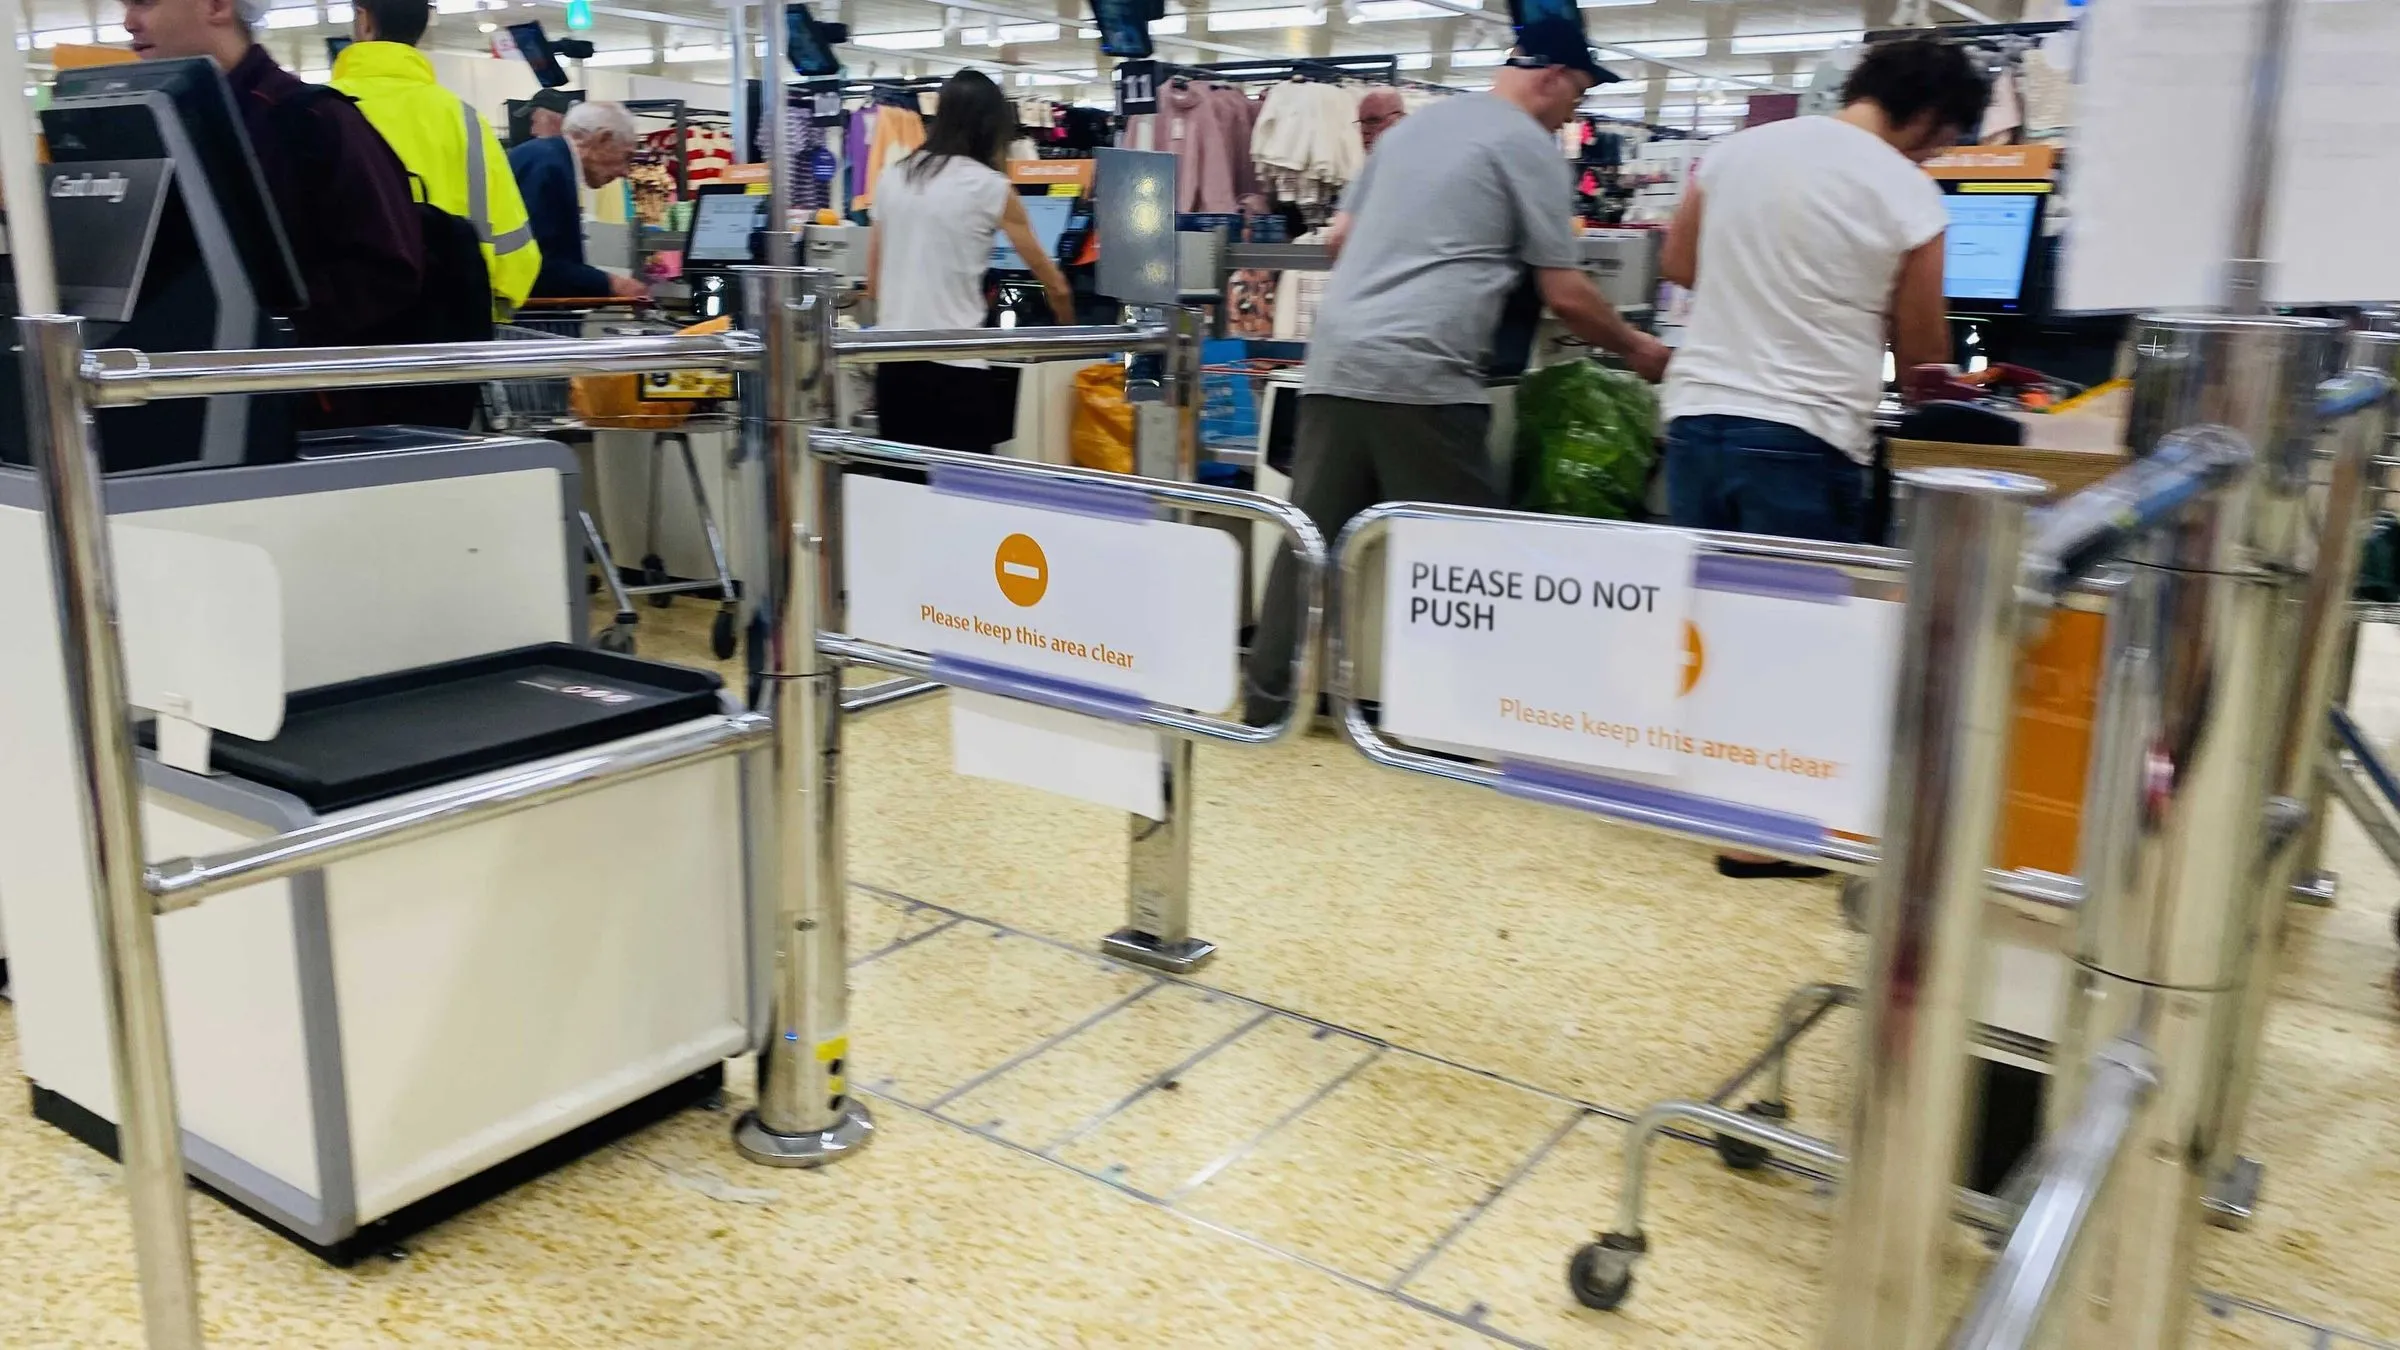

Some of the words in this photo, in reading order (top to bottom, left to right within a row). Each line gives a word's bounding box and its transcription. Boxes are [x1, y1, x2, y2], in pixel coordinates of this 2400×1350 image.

[1410, 597, 1494, 631] PUSH
[1411, 562, 1523, 600] PLEASE
[1534, 574, 1582, 605] DO
[1593, 581, 1660, 613] NOT
[921, 604, 970, 631] Please
[974, 615, 1012, 644] keep
[1016, 626, 1047, 649] this
[1051, 637, 1087, 658] area
[1091, 643, 1134, 669] clear
[1500, 698, 1575, 731] Please
[1582, 711, 1640, 748] keep
[1647, 726, 1694, 754] this
[1702, 738, 1758, 766] area
[1764, 748, 1836, 780] clear
